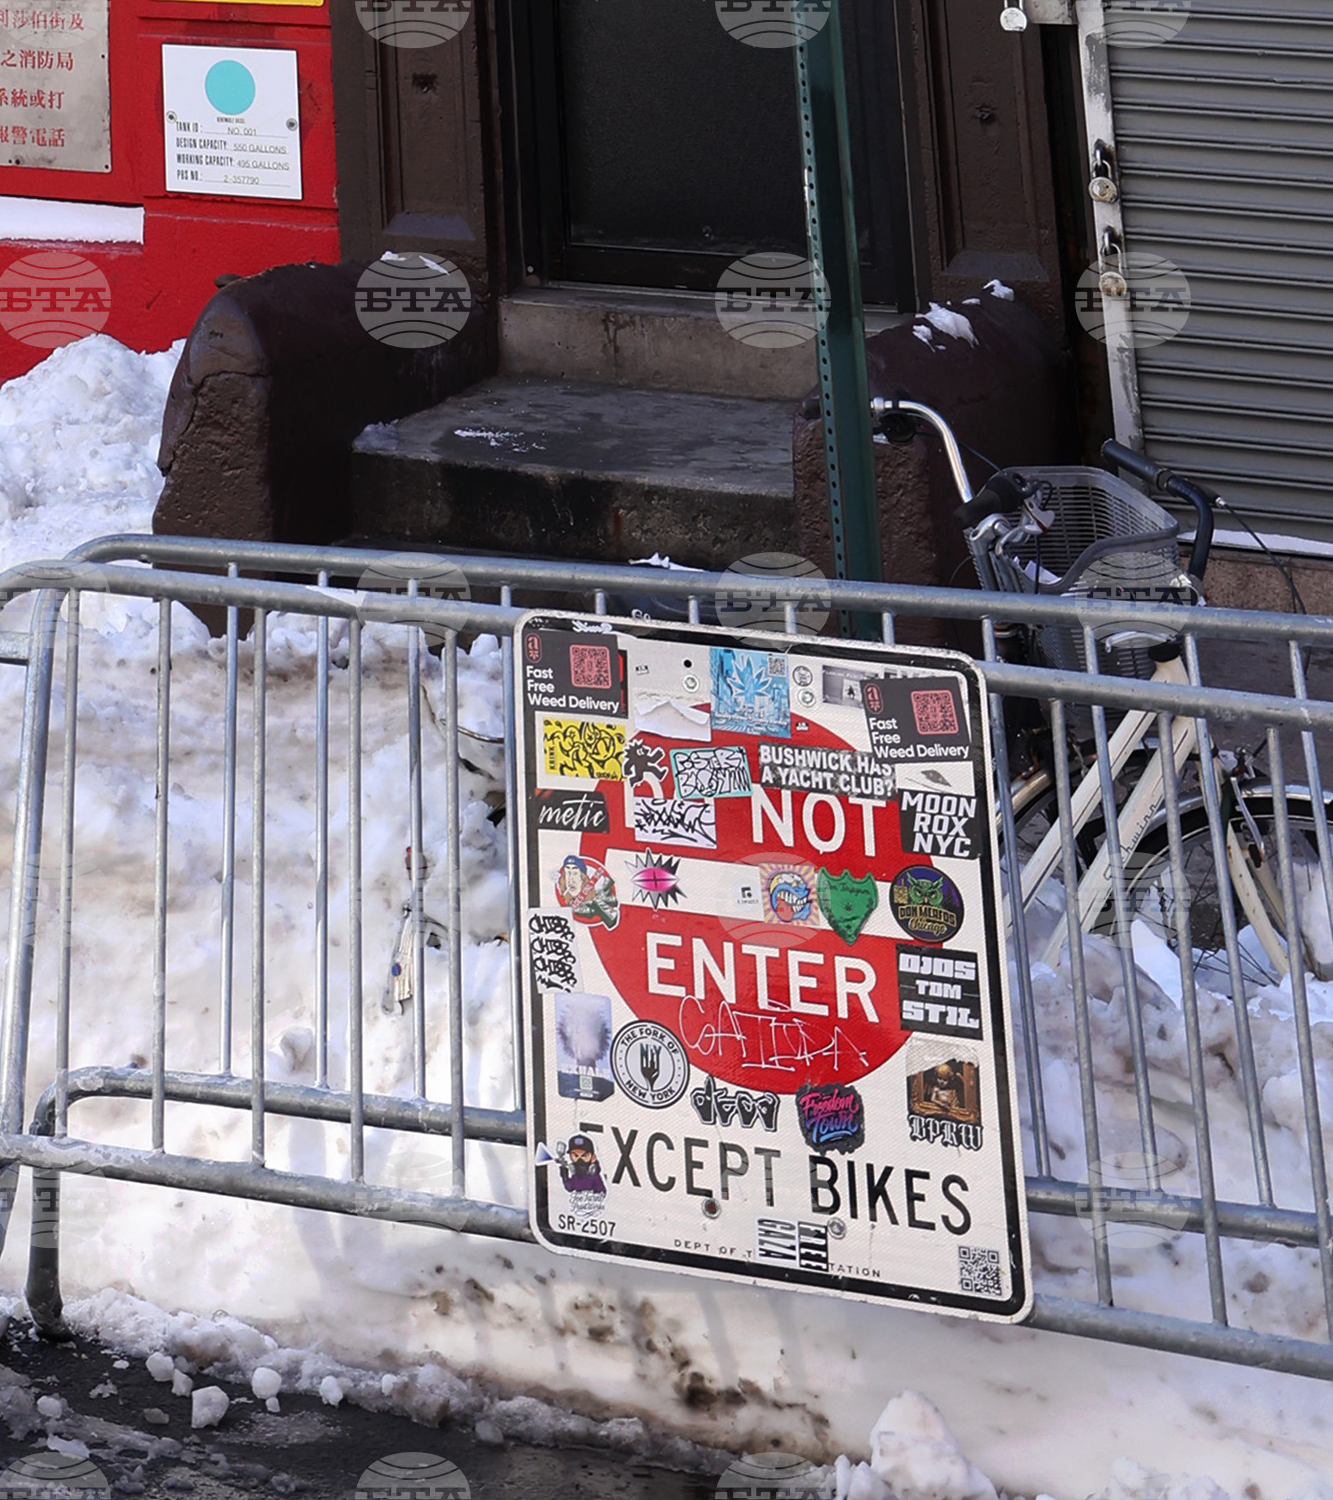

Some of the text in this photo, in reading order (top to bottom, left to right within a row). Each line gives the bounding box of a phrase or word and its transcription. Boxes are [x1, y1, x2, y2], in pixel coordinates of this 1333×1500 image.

[175, 121, 191, 133] TANK
[176, 137, 198, 149] DESIGN
[233, 143, 247, 152] 550
[248, 144, 287, 155] GALLONS
[176, 153, 203, 166] WORKING
[251, 160, 290, 171] GALLONS
[526, 665, 554, 680] Fast
[526, 679, 555, 693] Free
[527, 692, 620, 714] Weed Delivery
[868, 717, 898, 730] Fast
[871, 731, 902, 744] Free
[759, 745, 852, 773] BUSHWICK
[873, 743, 970, 760] Weed Delivery
[761, 766, 894, 797] A YACHT CLUB?
[901, 791, 977, 819] MOON
[750, 788, 887, 858] NOT
[913, 812, 968, 838] ROX
[912, 832, 972, 859] NYC
[908, 918, 948, 936] Chicago
[646, 931, 880, 1023] ENTER
[898, 952, 977, 981] OJOS
[620, 1027, 680, 1055] THE FORK OF
[625, 1079, 677, 1102] NEW YORK
[798, 1090, 860, 1118] Freedom
[807, 1110, 859, 1142] Town
[579, 1122, 972, 1236] XCEPT BIKES
[557, 1214, 617, 1238] SR-2507
[674, 1238, 711, 1252] DEPT
[718, 1246, 737, 1257] OF
[756, 1218, 797, 1263] GAZA
[798, 1221, 828, 1271] FREE
